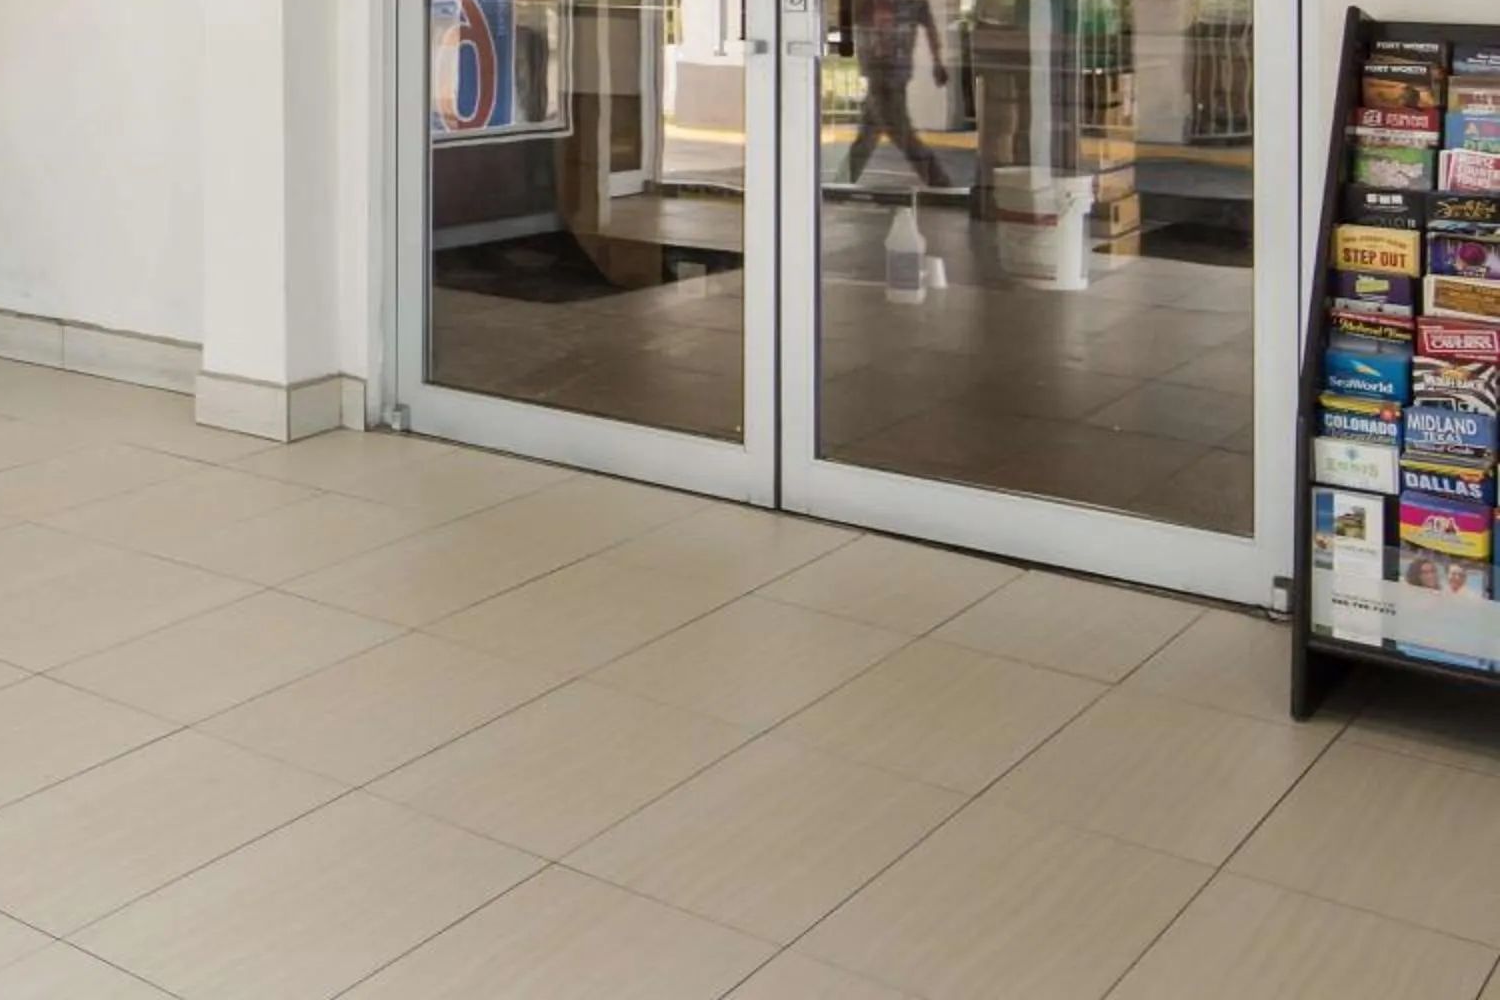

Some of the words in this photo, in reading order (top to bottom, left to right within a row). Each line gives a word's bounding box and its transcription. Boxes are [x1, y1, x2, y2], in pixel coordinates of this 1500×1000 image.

[1343, 248, 1378, 265] STEP
[1379, 251, 1407, 269] OUT
[1329, 375, 1394, 393] SeaWorld
[1324, 413, 1398, 436] COLORADO
[1407, 413, 1477, 436] MIDLAND
[1405, 472, 1484, 499] DALLAS
